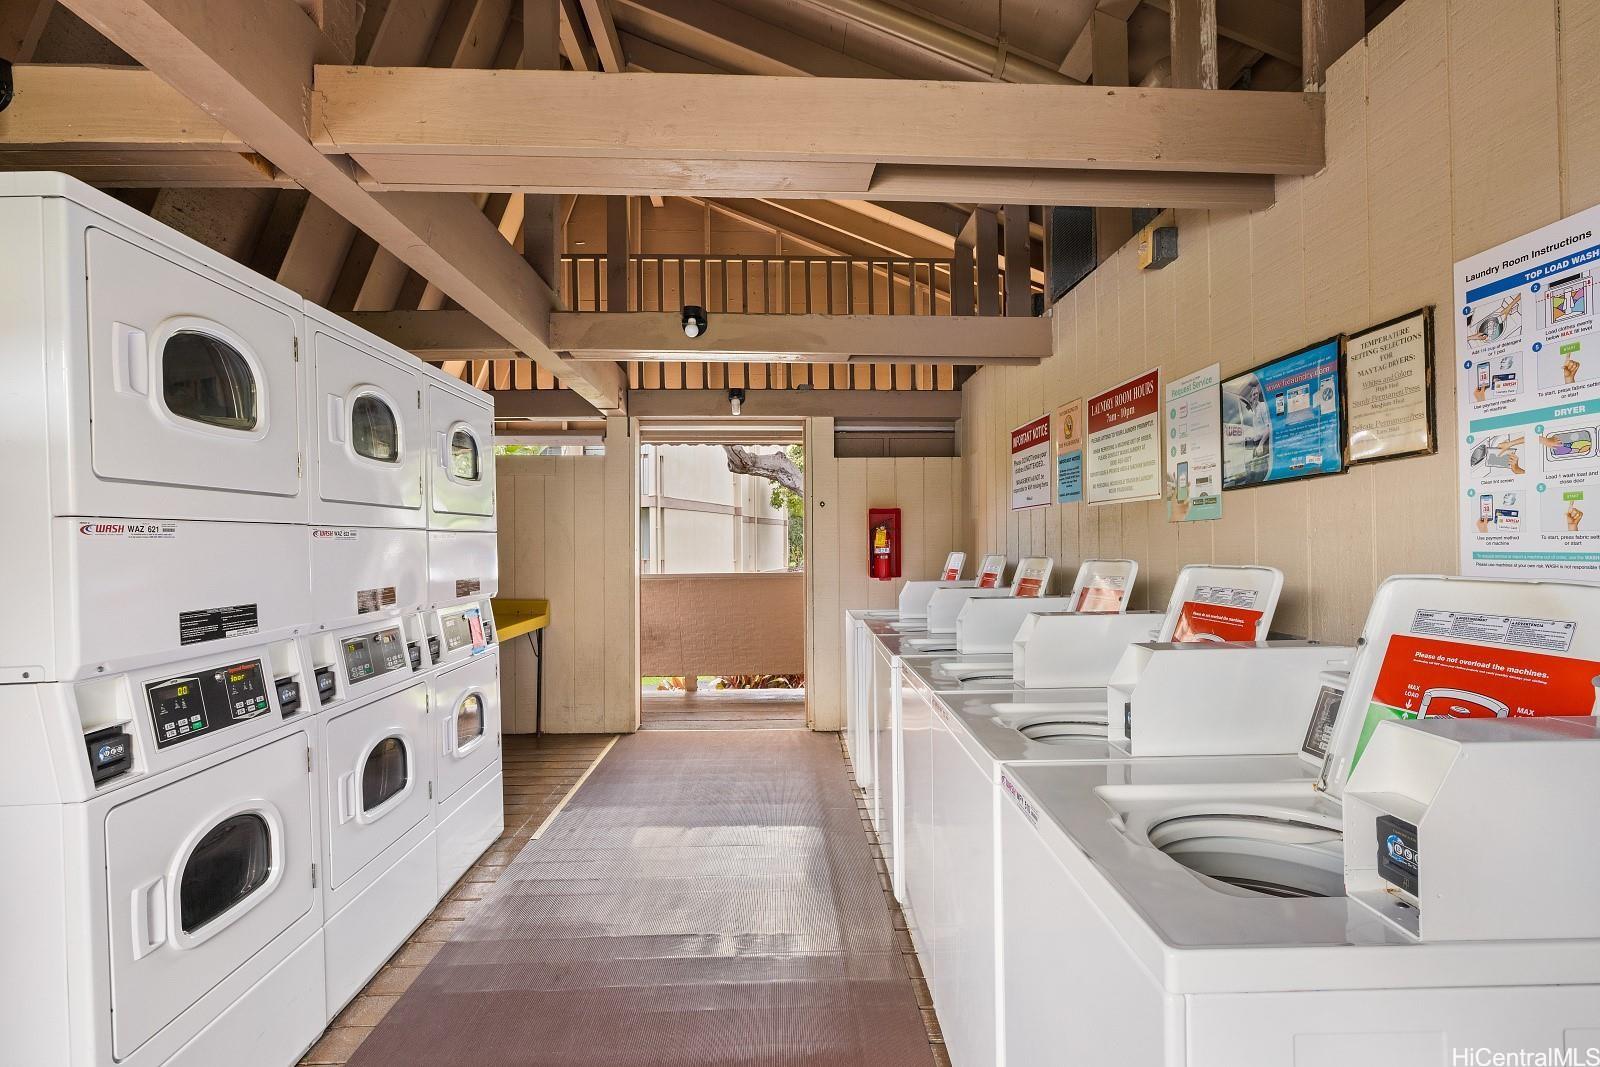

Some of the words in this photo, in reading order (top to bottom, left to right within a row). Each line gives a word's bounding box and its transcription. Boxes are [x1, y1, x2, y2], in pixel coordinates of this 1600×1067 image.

[1465, 265, 1500, 283] Laundry
[1502, 254, 1529, 270] Room
[1531, 230, 1592, 259] Instructions
[1524, 269, 1543, 281] TOP
[1544, 260, 1569, 274] LOAD
[1350, 347, 1379, 361] SETTING
[1379, 331, 1422, 352] SELECTIONS
[1360, 326, 1410, 350] TEMPERATURE
[1357, 364, 1387, 377] MAYTAG
[1388, 353, 1416, 369] DRYERS:
[1379, 352, 1393, 362] FOR
[1171, 384, 1192, 398] Request
[1192, 376, 1213, 390] Service
[1091, 397, 1114, 417] LAUNDRY
[1114, 389, 1132, 407] ROOM
[1133, 380, 1154, 400] HOURS
[1554, 405, 1585, 417] DRYER
[1033, 423, 1048, 441] NOTICE
[95, 524, 125, 533] WASH
[127, 525, 145, 533] WAZ
[147, 525, 159, 533] 621
[1415, 651, 1436, 660] Please
[1436, 654, 1445, 662] do
[1459, 659, 1491, 669] overload
[1492, 663, 1505, 671] the
[1506, 666, 1550, 679] machines.
[1404, 690, 1420, 699] LOAD
[1407, 683, 1420, 691] MAX
[1516, 706, 1535, 716] MAX
